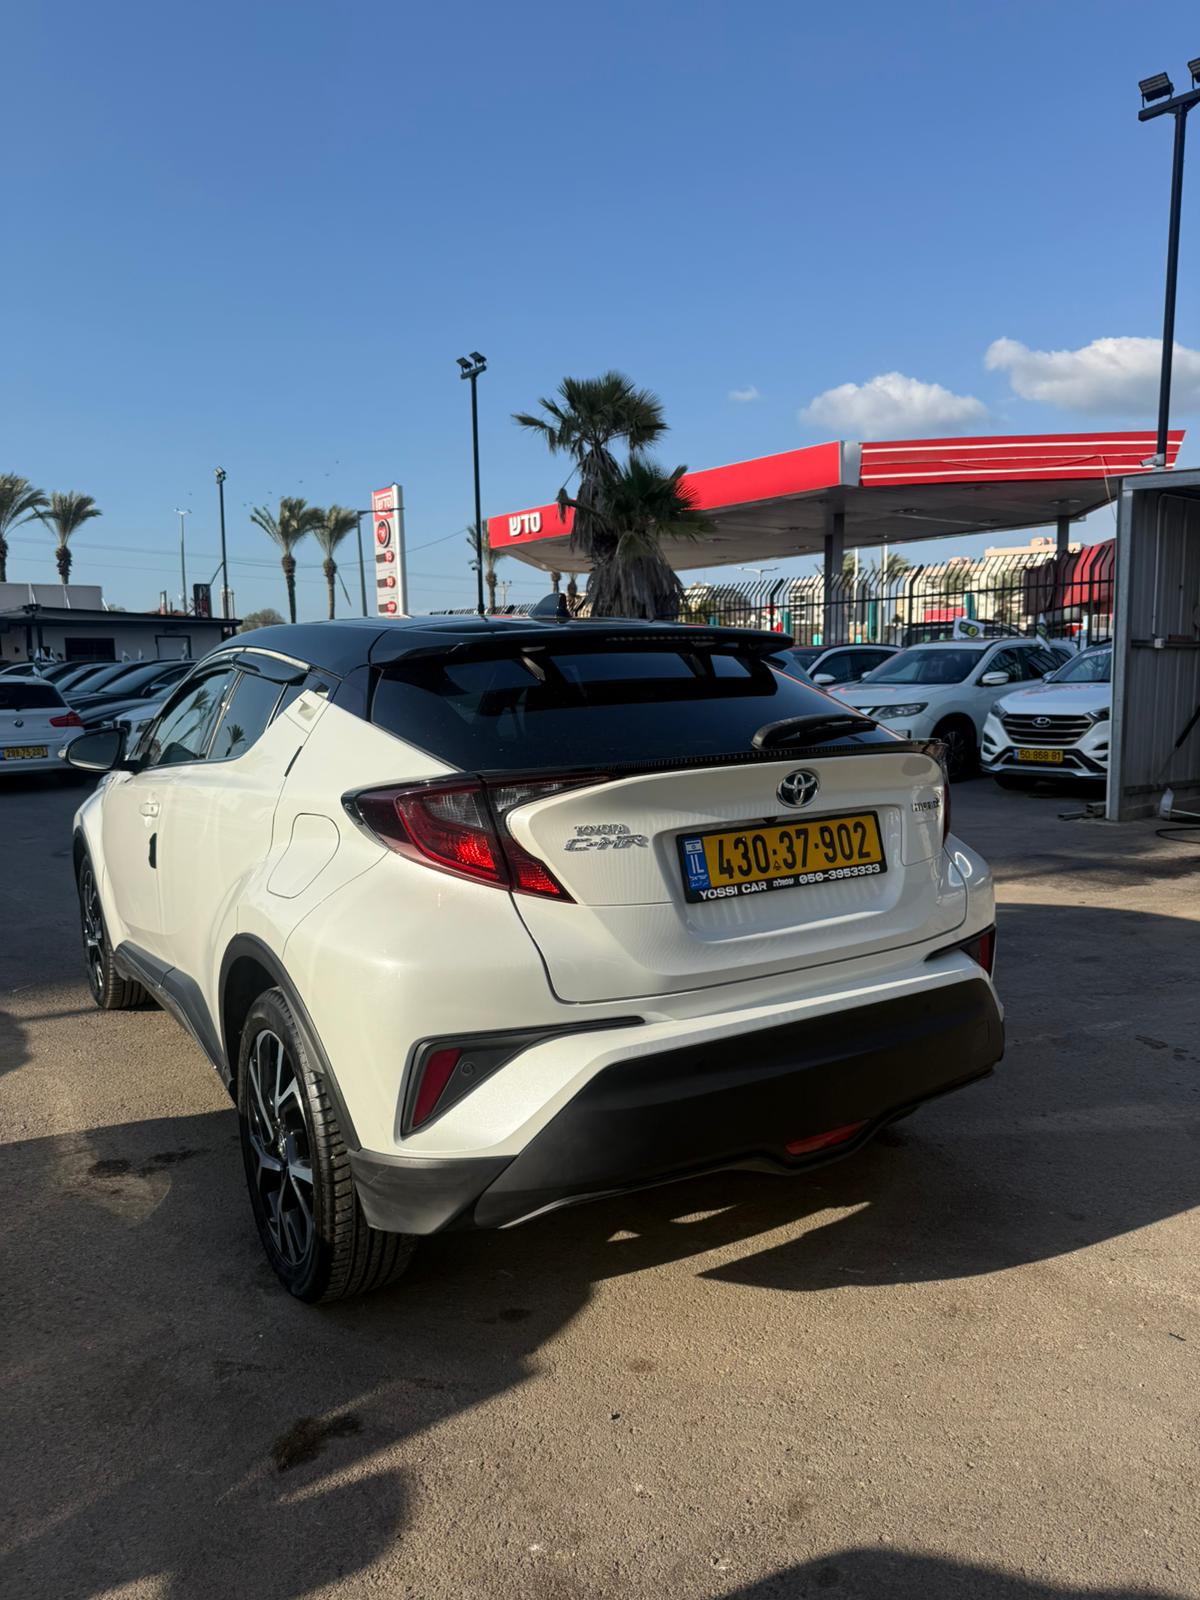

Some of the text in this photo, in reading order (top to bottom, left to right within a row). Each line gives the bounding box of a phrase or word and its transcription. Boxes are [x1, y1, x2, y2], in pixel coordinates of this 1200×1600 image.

[508, 511, 541, 537] סדש
[699, 885, 738, 900] YOSSI
[741, 881, 767, 894] CAR
[799, 863, 881, 885] 050-3953333
